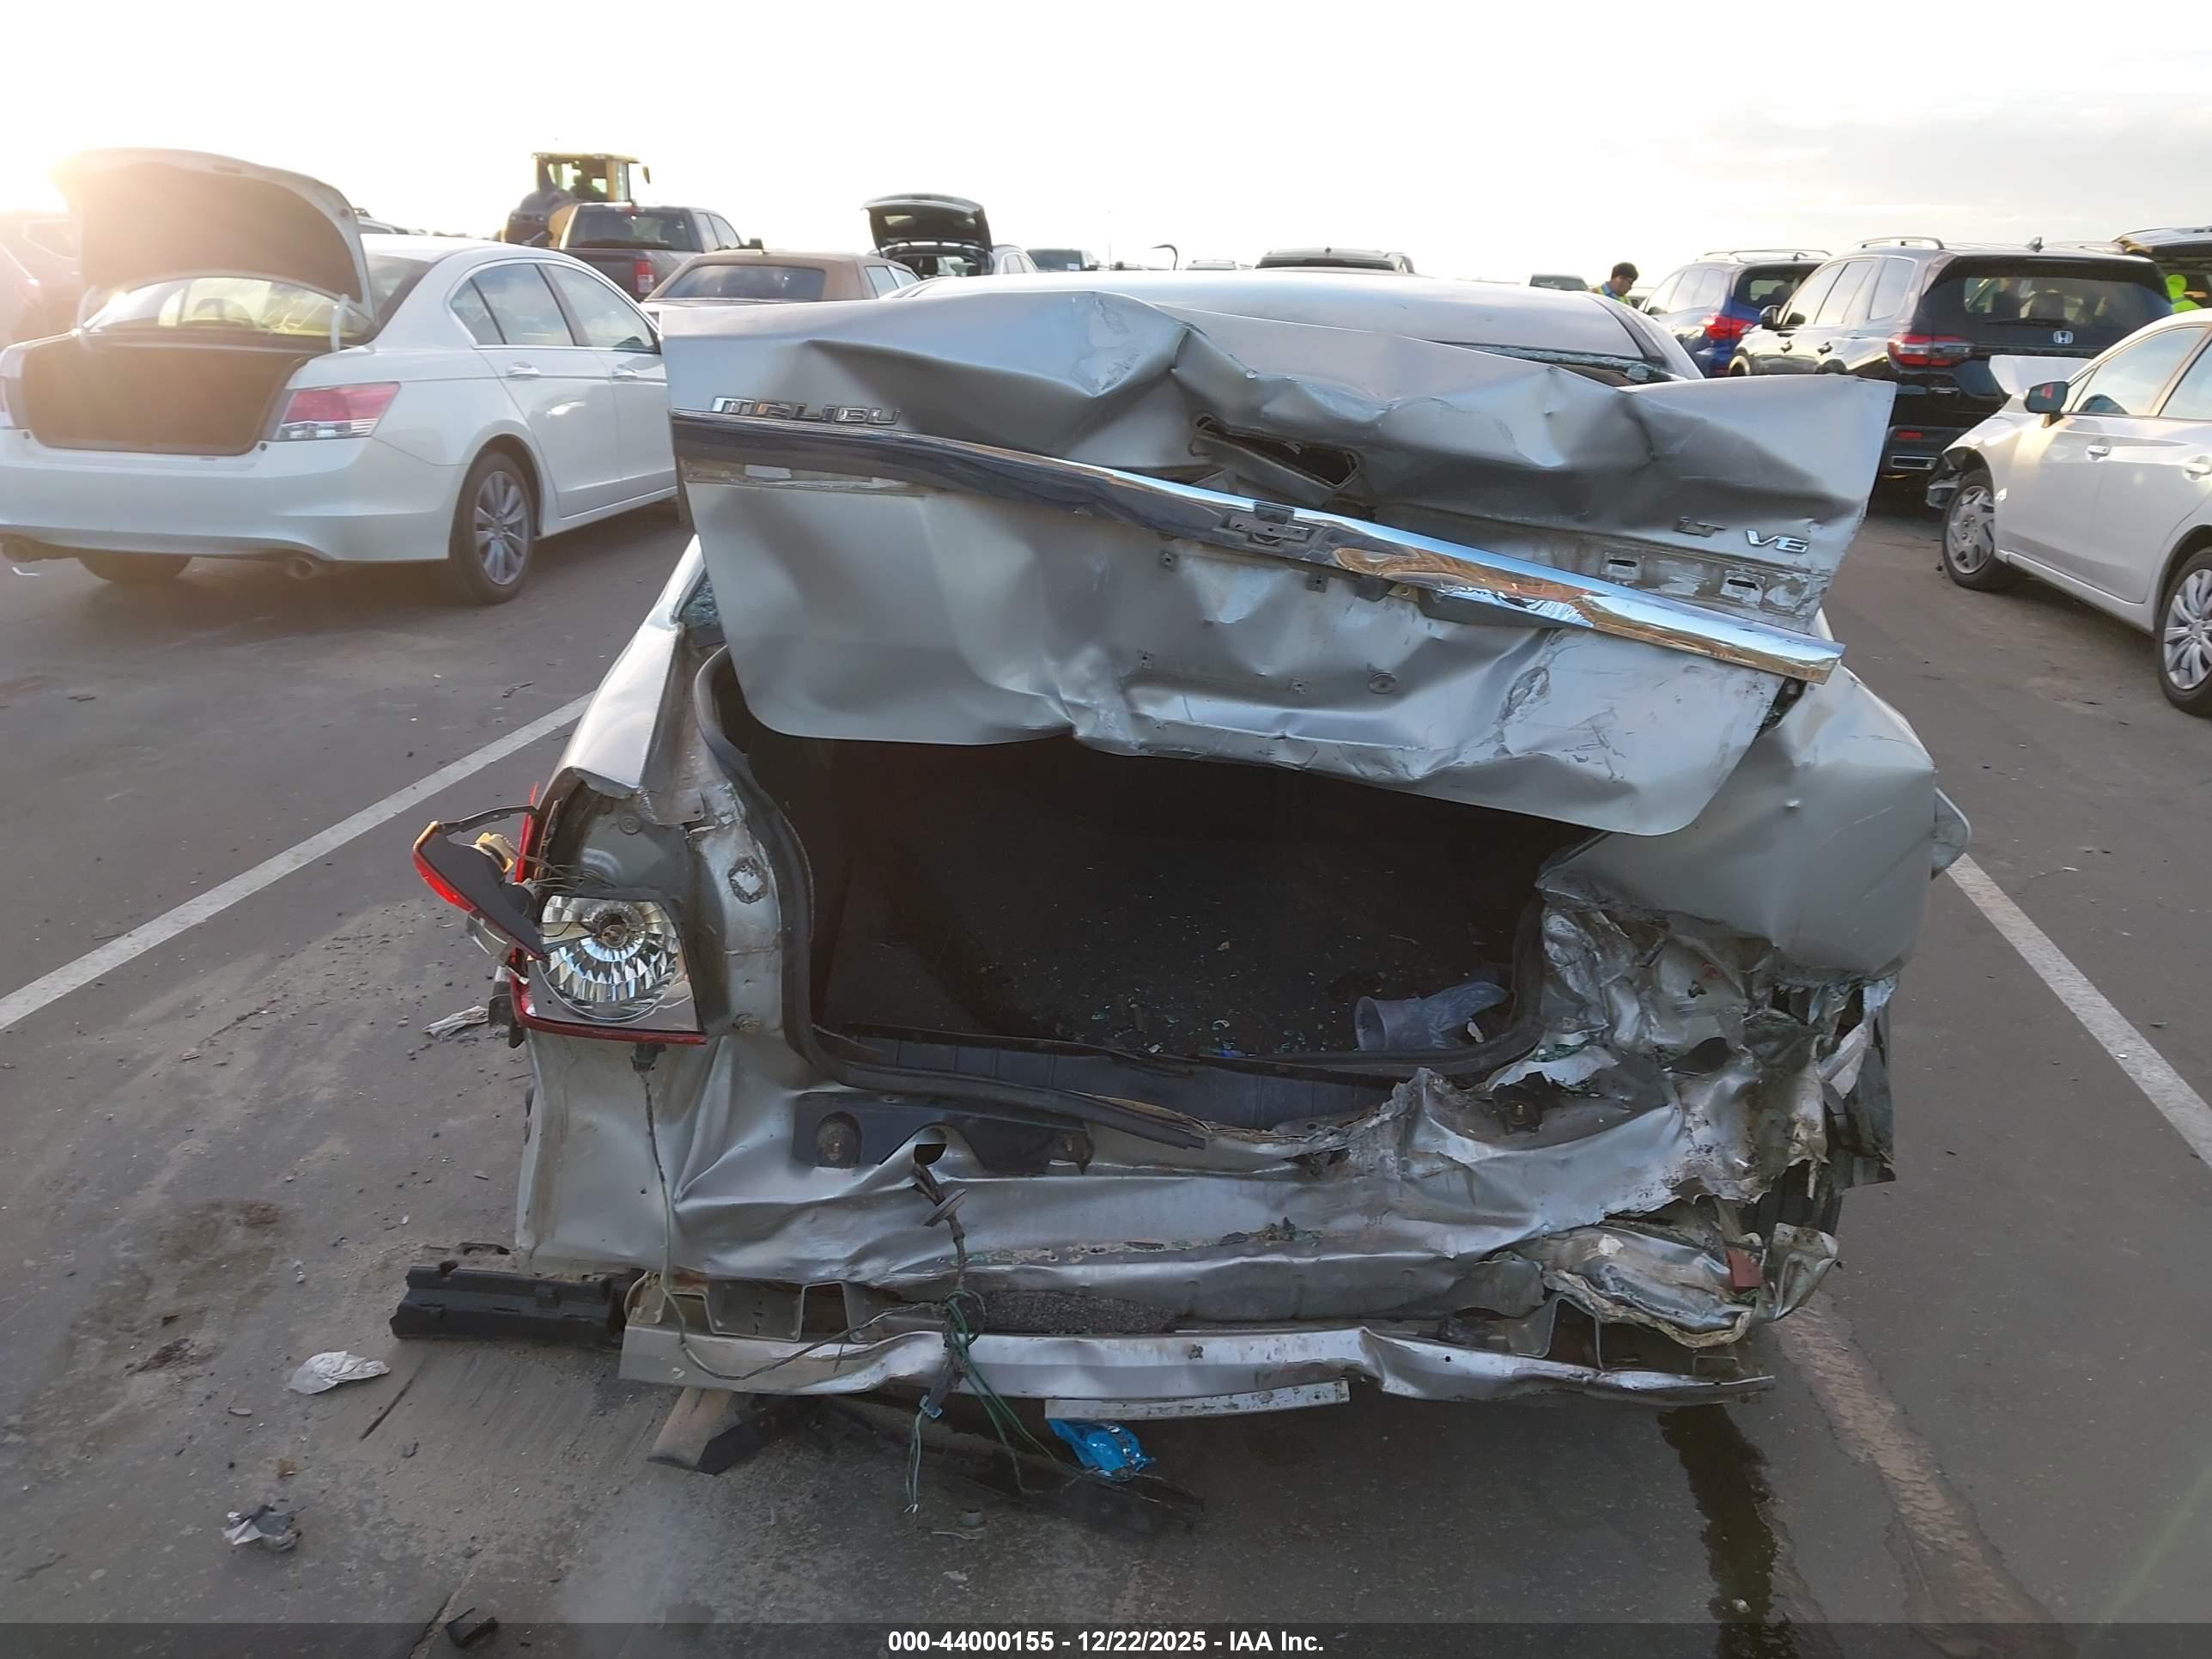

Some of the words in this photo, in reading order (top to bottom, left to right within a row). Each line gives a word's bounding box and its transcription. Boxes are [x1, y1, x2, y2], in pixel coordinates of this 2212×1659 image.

[712, 396, 901, 424] MALIBU
[1673, 516, 1728, 538] LT
[1745, 529, 1810, 553] V6
